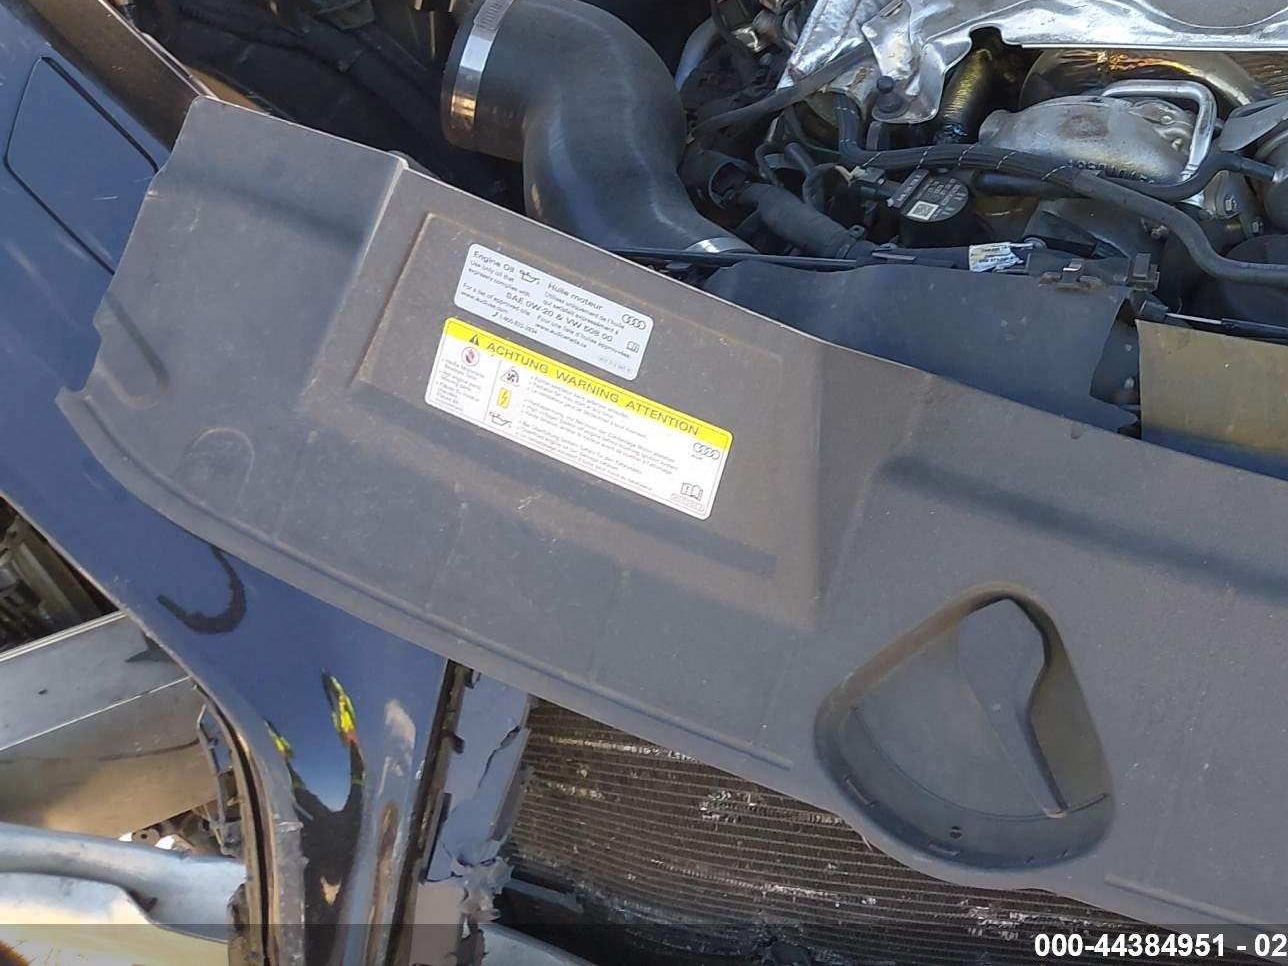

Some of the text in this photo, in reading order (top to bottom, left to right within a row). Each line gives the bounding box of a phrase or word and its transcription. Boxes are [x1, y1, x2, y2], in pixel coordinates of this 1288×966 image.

[471, 250, 515, 273] Engine Oil
[547, 282, 602, 310] Huile moteur
[505, 291, 524, 304] SAE
[565, 317, 582, 328] VW
[600, 332, 613, 342] 00
[486, 342, 549, 374] ACHTUNG
[555, 372, 619, 403] WARNING
[626, 400, 699, 436] ATTENTION
